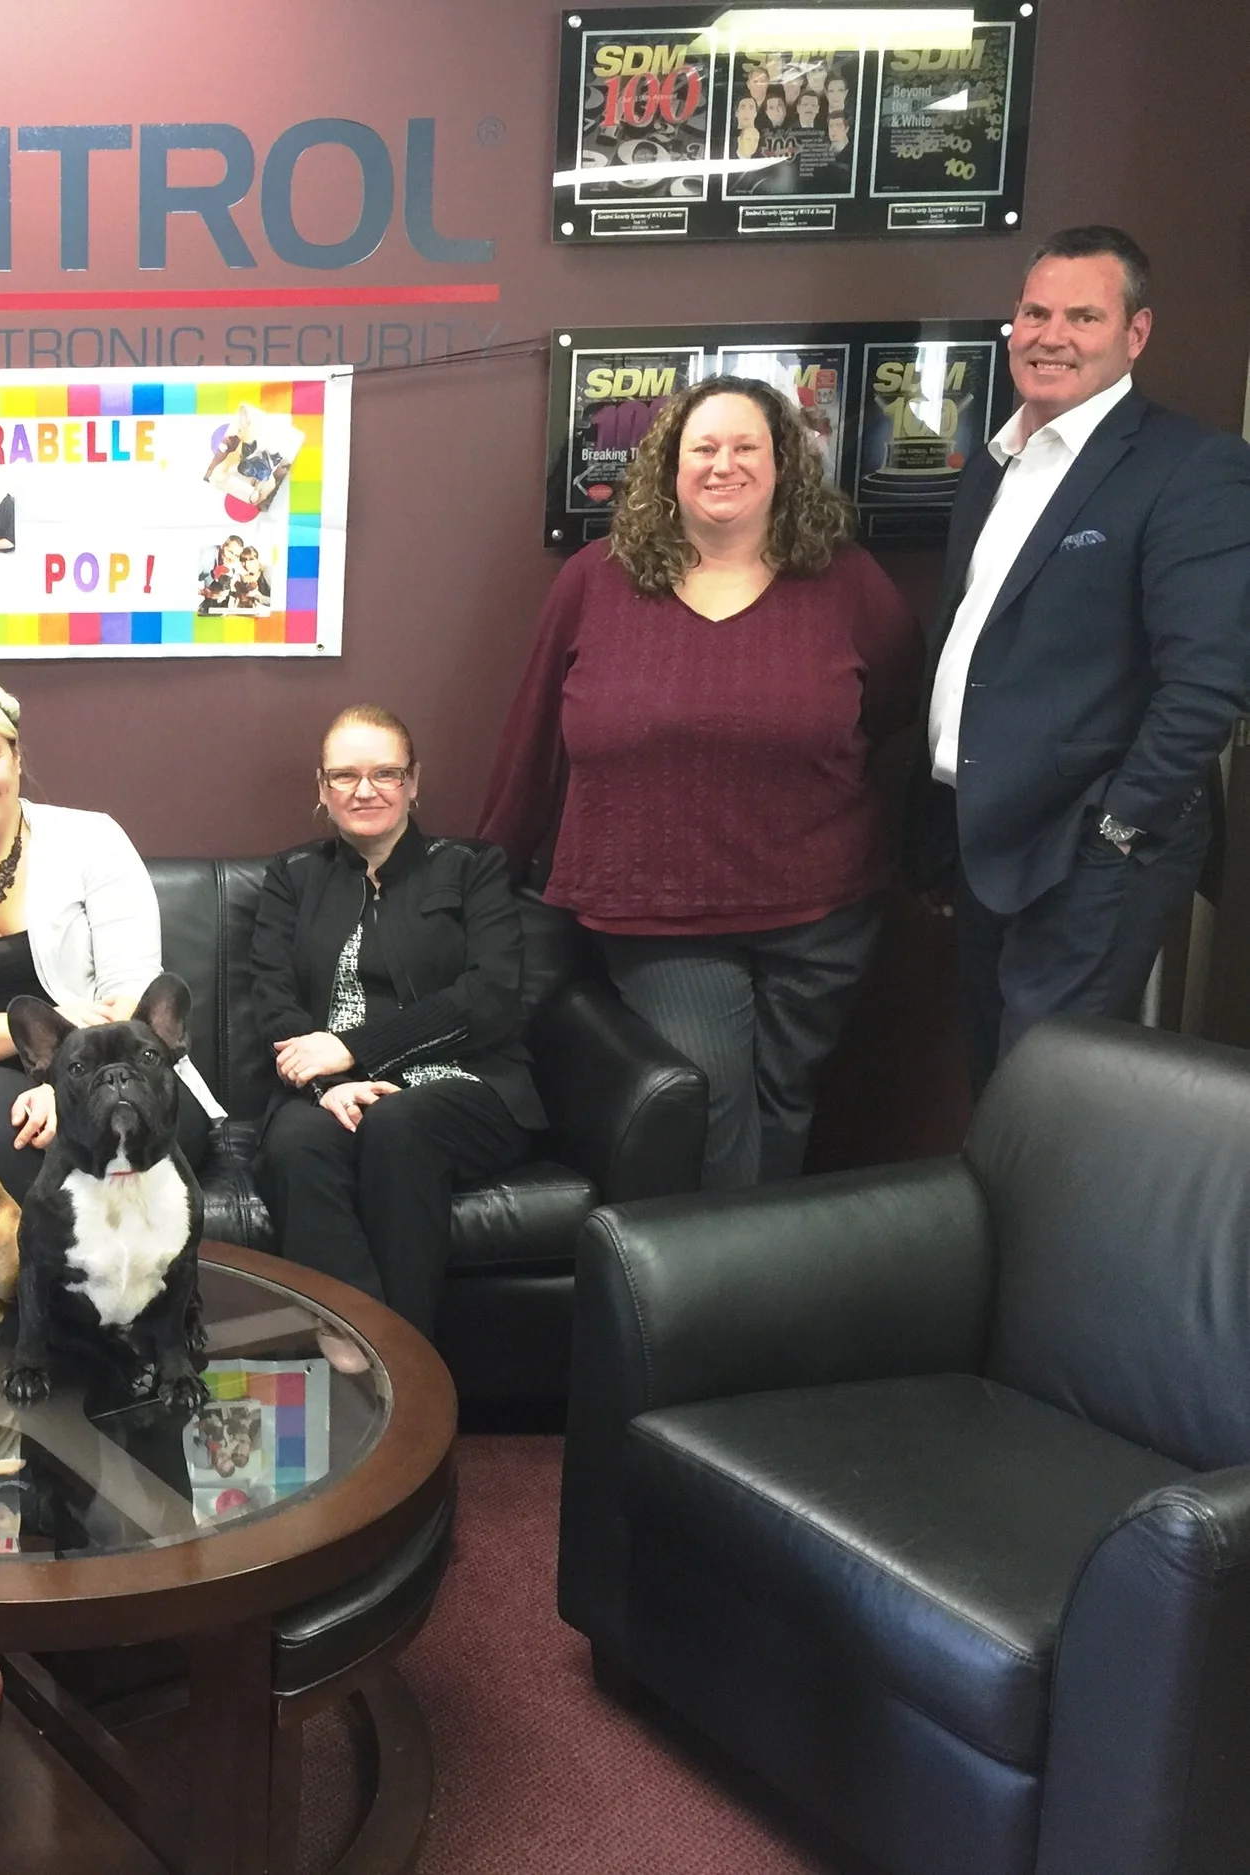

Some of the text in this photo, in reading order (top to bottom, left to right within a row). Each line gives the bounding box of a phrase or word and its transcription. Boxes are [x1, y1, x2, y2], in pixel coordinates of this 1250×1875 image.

[593, 44, 689, 77] SDM
[890, 39, 986, 71] SDM
[600, 65, 702, 128] 100
[891, 100, 909, 112] the
[893, 84, 932, 99] Beyond
[902, 114, 932, 127] White
[944, 157, 976, 181] 100
[224, 321, 502, 370] SECURITY
[584, 367, 677, 398] SDM
[590, 396, 675, 450] 10
[581, 446, 628, 462] Breaking
[45, 551, 155, 595] POP!
